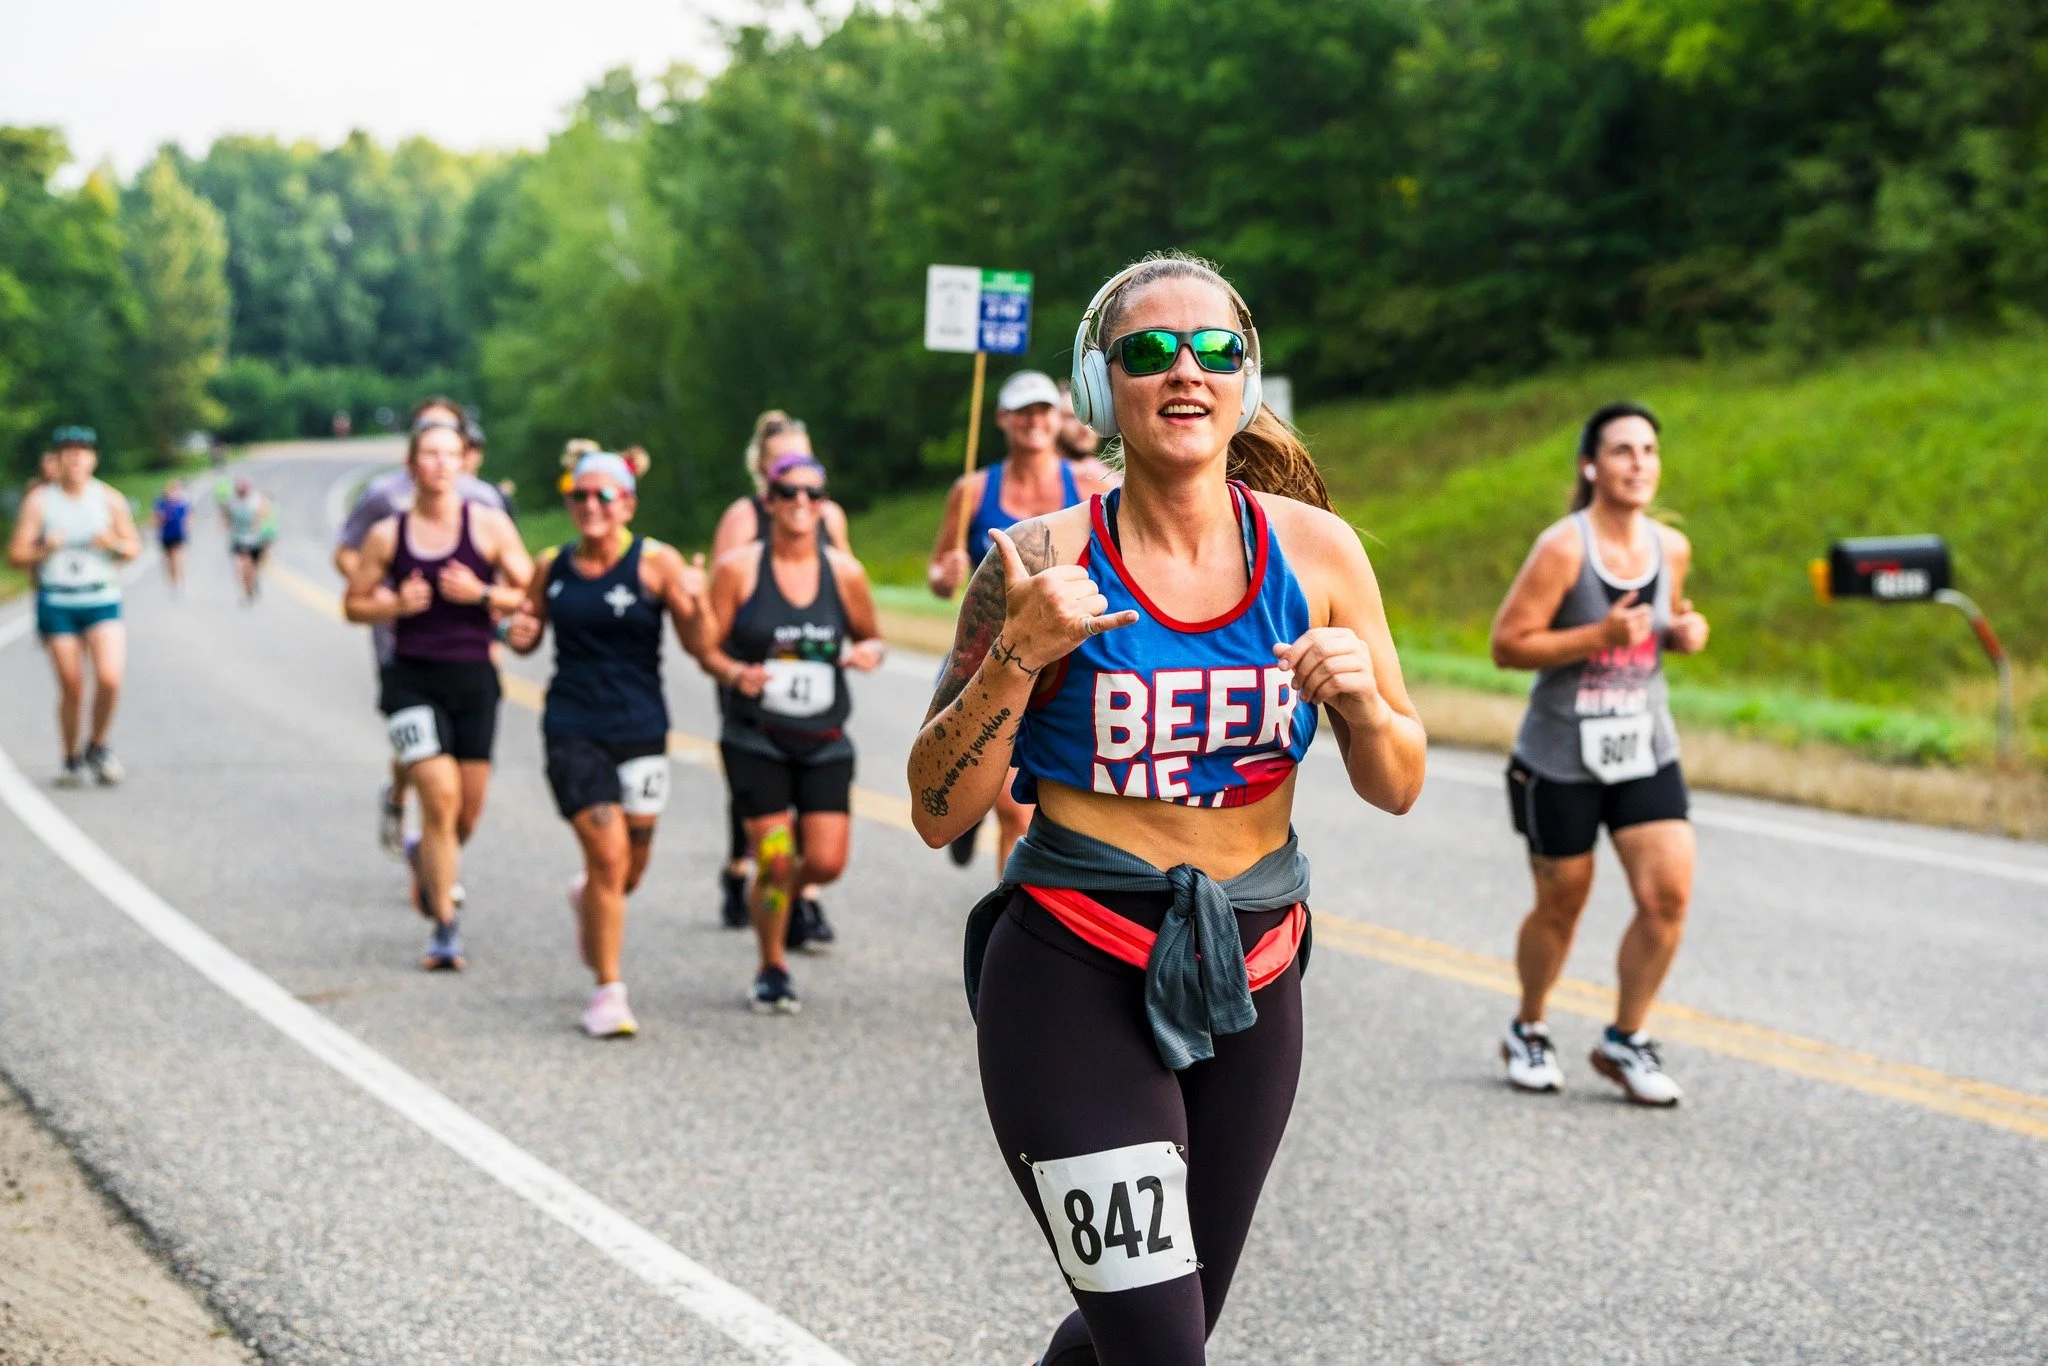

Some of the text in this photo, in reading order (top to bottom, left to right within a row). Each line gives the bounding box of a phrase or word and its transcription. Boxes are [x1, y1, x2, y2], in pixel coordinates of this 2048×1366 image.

[969, 707, 1011, 755] sunshine
[1093, 665, 1297, 760] BEER
[1064, 1175, 1174, 1265] 842
